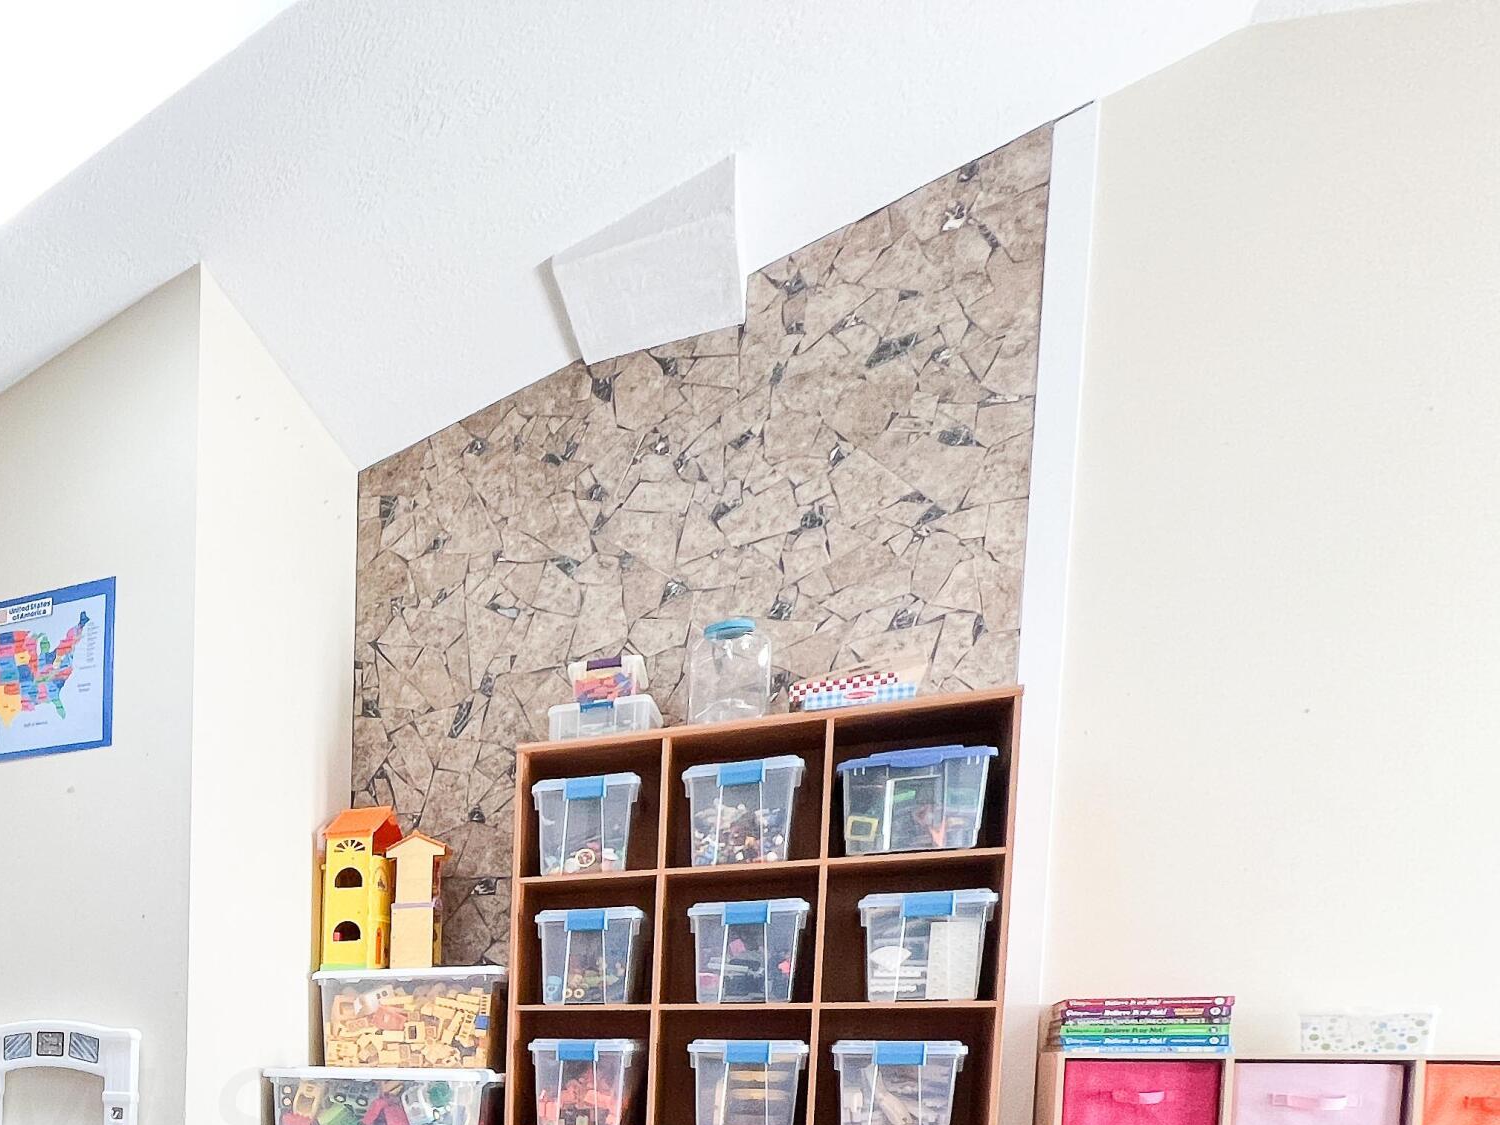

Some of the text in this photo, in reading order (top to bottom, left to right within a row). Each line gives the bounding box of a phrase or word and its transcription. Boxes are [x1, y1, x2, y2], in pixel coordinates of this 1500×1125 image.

[8, 600, 51, 615] United States
[19, 609, 47, 620] America
